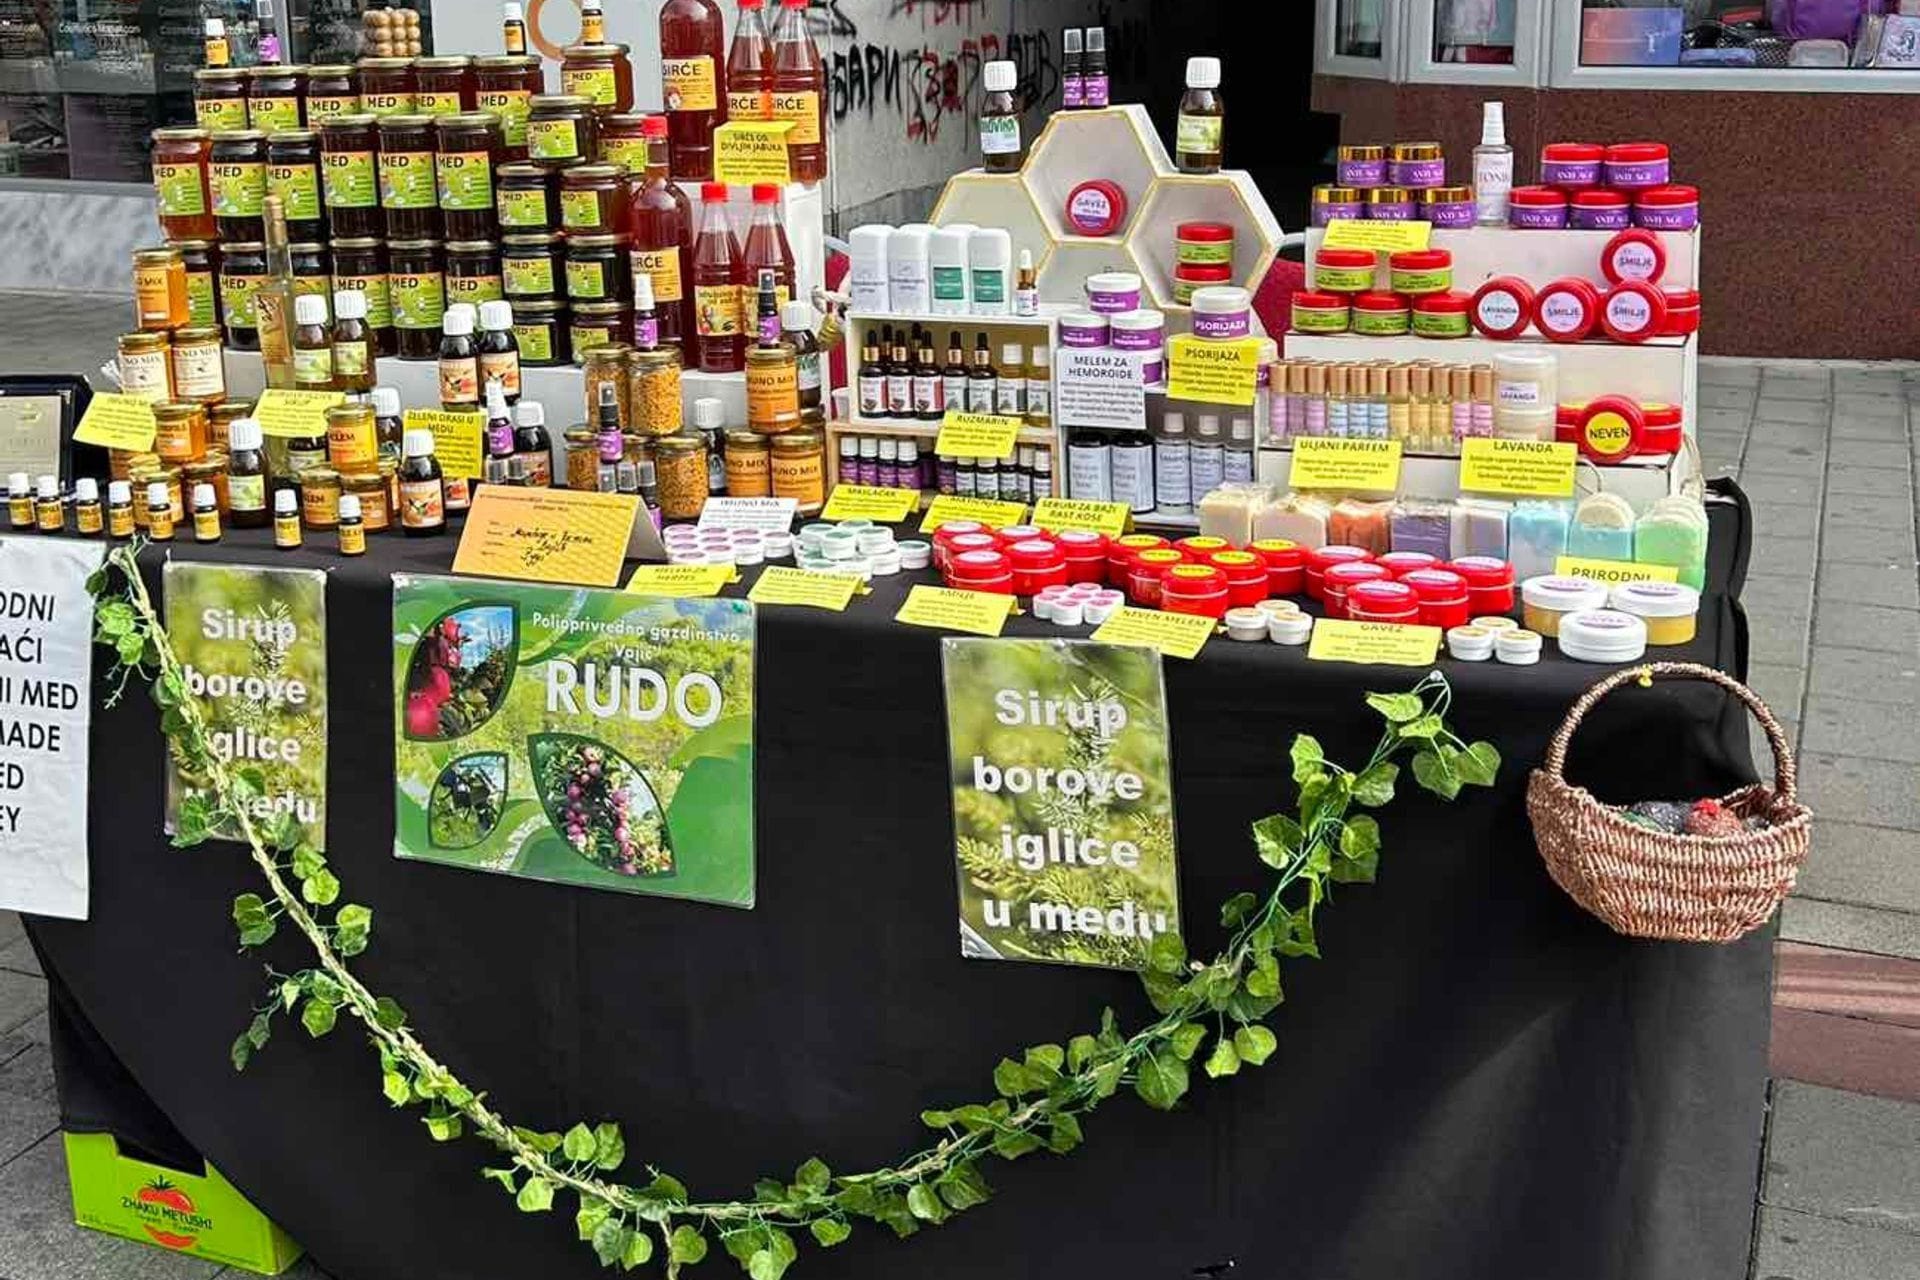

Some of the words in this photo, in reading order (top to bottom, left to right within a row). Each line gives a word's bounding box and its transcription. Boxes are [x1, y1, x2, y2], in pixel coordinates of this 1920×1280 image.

[311, 100, 341, 112] MED
[367, 96, 397, 108] MED
[481, 95, 509, 107] MED
[322, 155, 350, 168] MED
[381, 155, 410, 168] MED
[439, 155, 465, 168] MED
[213, 164, 242, 177] MED
[337, 278, 367, 291] MED
[391, 276, 419, 289] MED
[450, 279, 478, 292] MED
[1074, 356, 1111, 366] MELEM
[1114, 357, 1128, 367] ZA
[1068, 367, 1133, 379] HEMOROIDE
[1589, 426, 1629, 439] NEVEN
[1300, 439, 1340, 452] ULJANI
[1493, 441, 1554, 454] LAVANDA
[201, 609, 298, 651] Sirup
[532, 612, 646, 638] Poljoprivredno
[649, 620, 741, 643] gazdinstvo
[184, 664, 308, 704] borove
[21, 679, 79, 711] MED
[546, 659, 724, 728] RUDO
[995, 688, 1128, 739] Sirup
[211, 727, 302, 763] glice
[972, 755, 1145, 801] borove
[240, 790, 318, 824] edu
[1000, 824, 1140, 871] iglice
[982, 899, 1011, 928] u
[1029, 901, 1168, 939] medu
